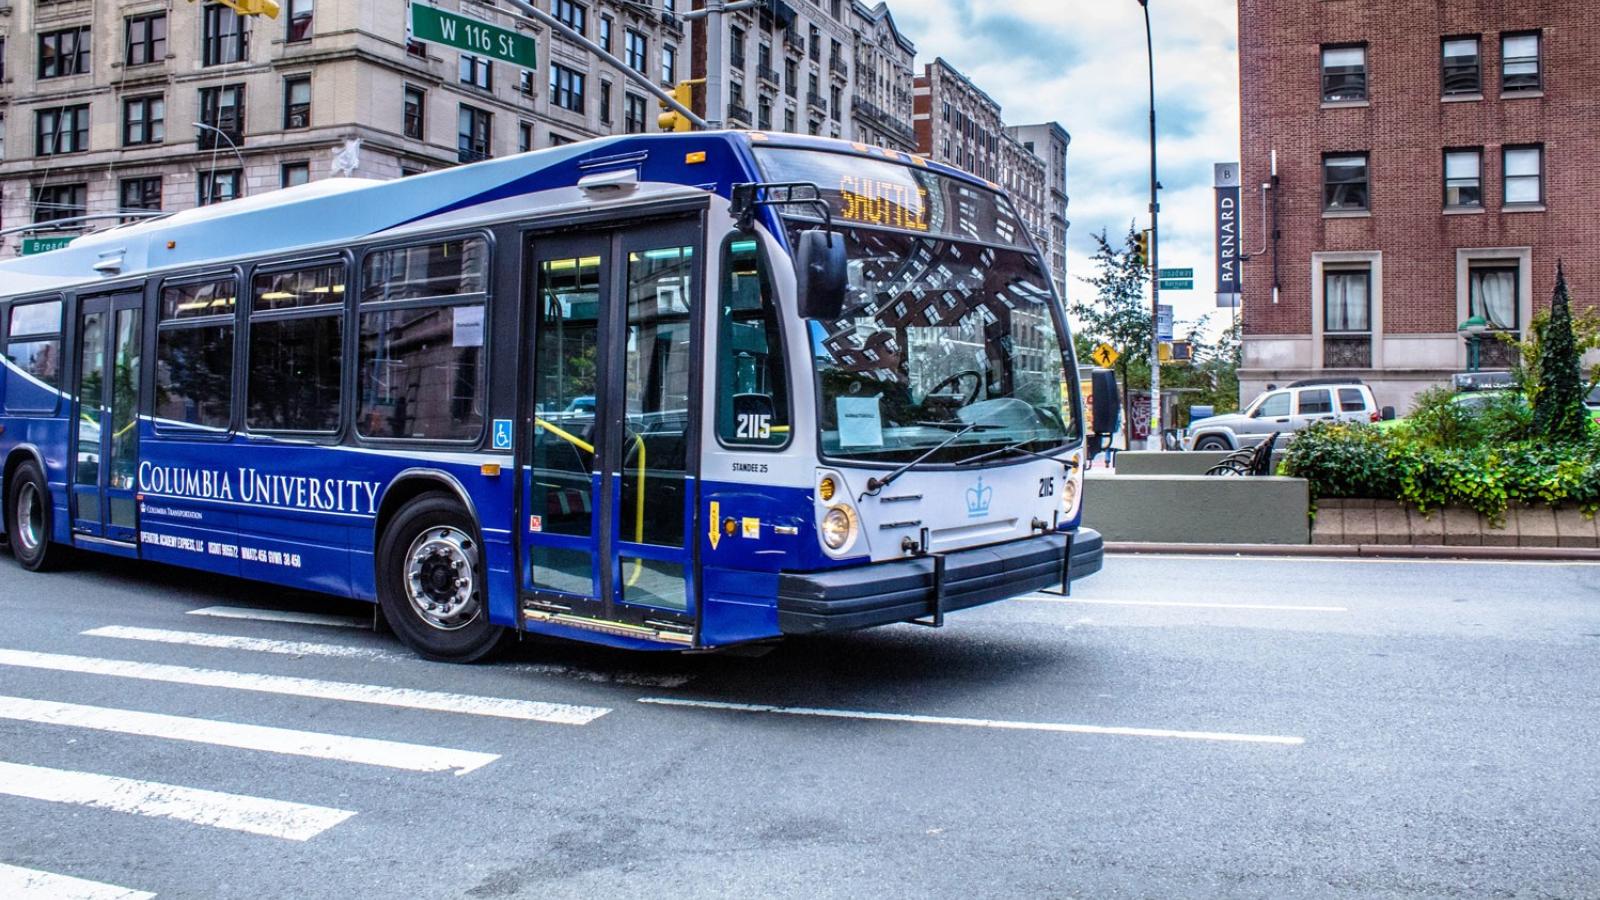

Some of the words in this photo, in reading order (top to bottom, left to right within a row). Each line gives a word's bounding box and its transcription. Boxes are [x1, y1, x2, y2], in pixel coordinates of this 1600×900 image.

[440, 16, 456, 41] W
[465, 24, 491, 51] 116
[499, 34, 515, 58] St
[1223, 170, 1232, 179] B
[840, 176, 928, 230] SHUTTLE
[1221, 197, 1235, 282] BARNARD
[736, 413, 771, 439] 2115
[732, 462, 758, 473] STANDEE
[759, 464, 768, 473] 25
[138, 460, 234, 500] COLUMBIA
[238, 467, 381, 513] UNIVERSITY
[1038, 476, 1054, 498] 2115
